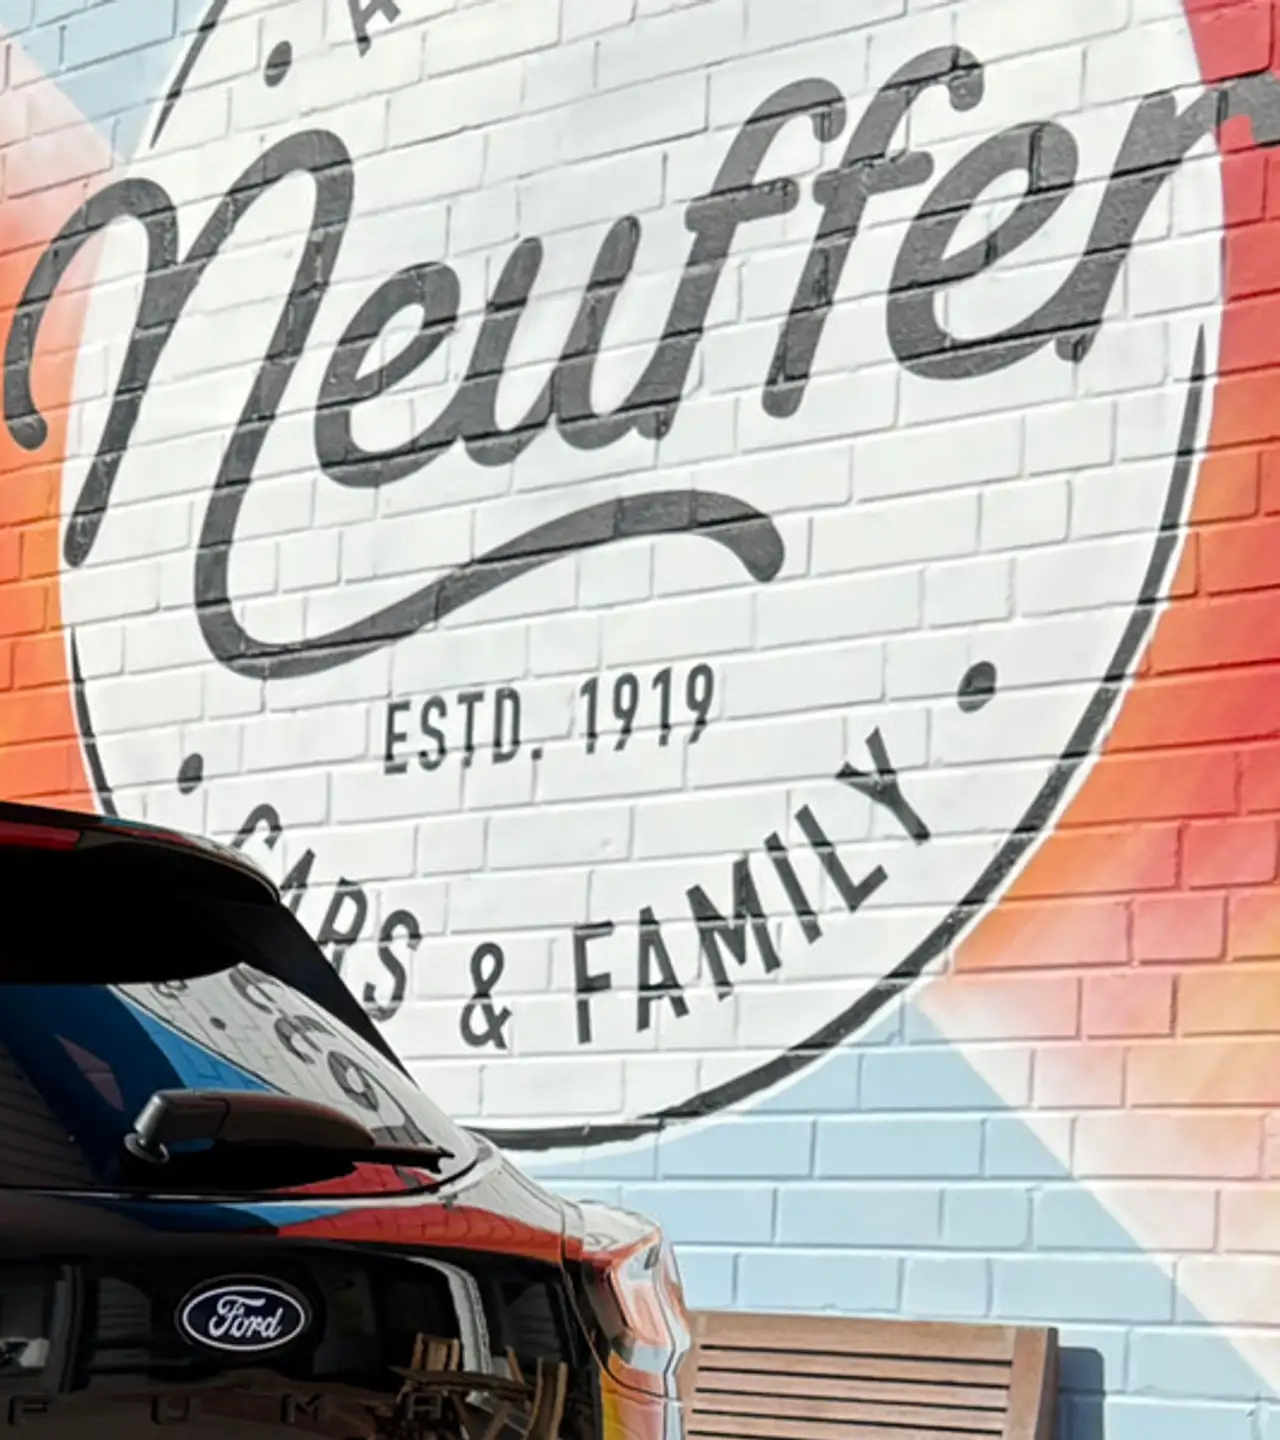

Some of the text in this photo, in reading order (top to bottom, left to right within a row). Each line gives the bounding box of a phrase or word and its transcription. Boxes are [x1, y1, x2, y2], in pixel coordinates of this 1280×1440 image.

[2, 45, 1280, 680] Neuffer
[384, 663, 715, 775] ESTD. 1919
[458, 942, 512, 1050] &
[572, 727, 932, 1044] FAMILY
[208, 1294, 284, 1339] Ford
